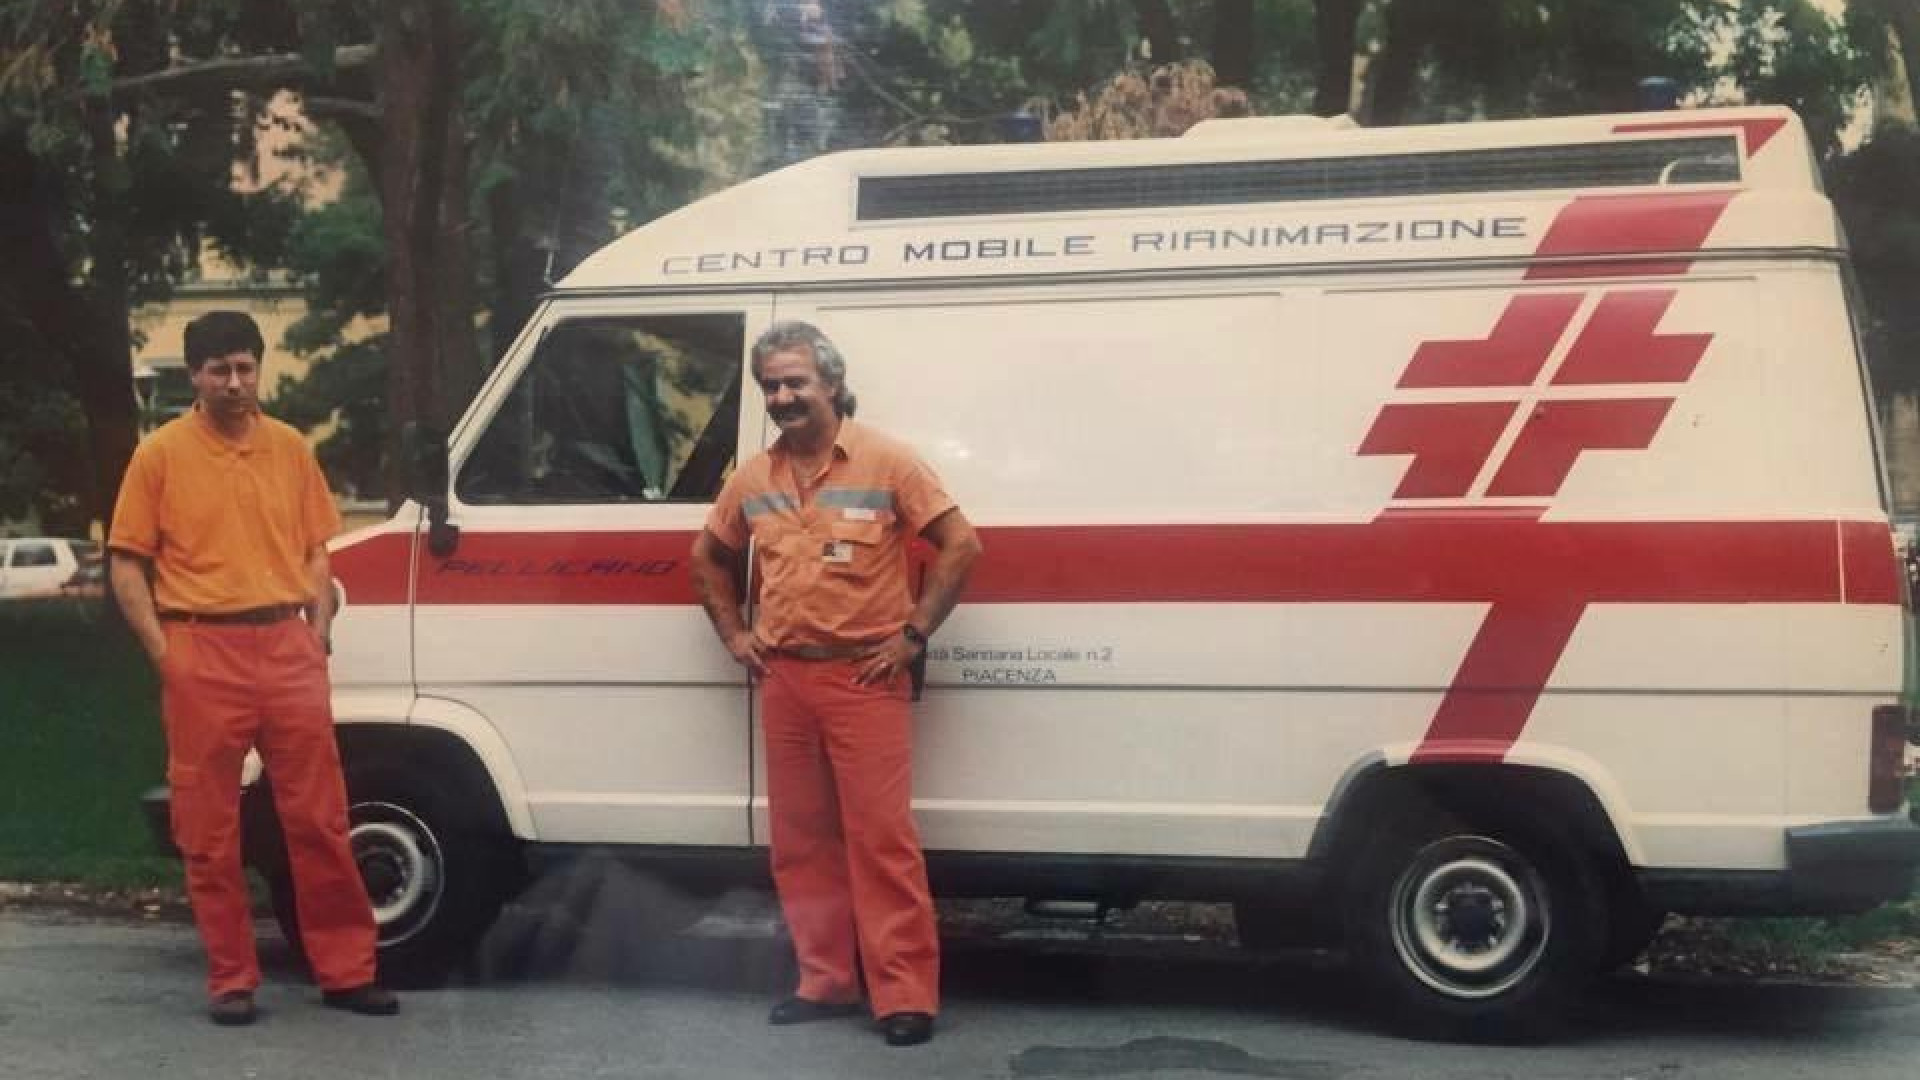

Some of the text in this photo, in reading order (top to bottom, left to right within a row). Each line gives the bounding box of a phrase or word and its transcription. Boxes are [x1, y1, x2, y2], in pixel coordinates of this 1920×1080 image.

[662, 217, 1528, 275] CENTRO MOBILE RIANIMAZIONE
[962, 668, 1057, 683] PIACENZA
